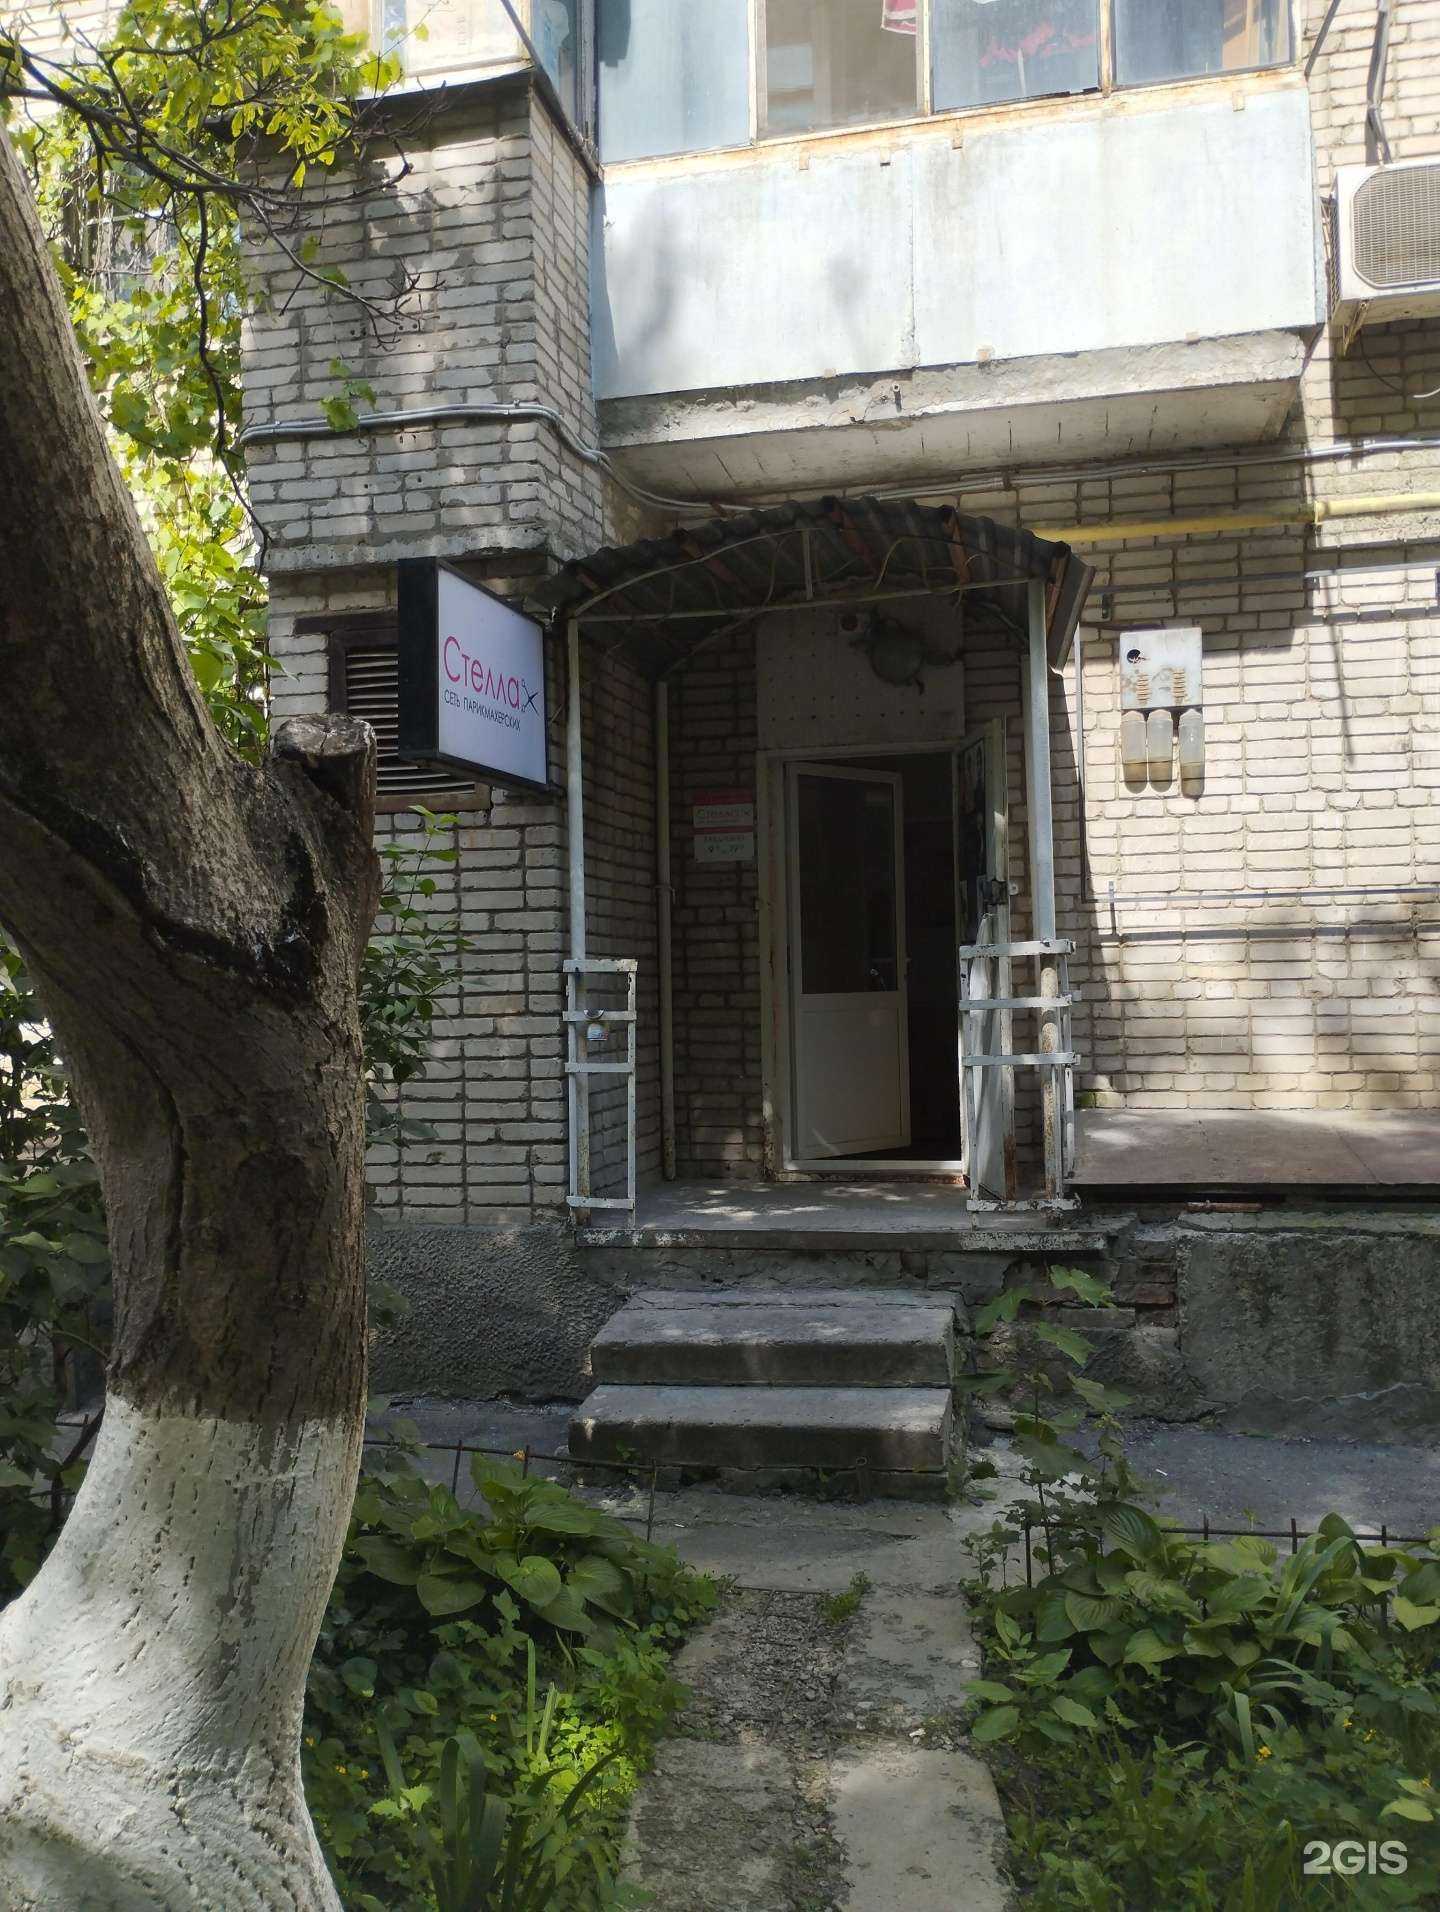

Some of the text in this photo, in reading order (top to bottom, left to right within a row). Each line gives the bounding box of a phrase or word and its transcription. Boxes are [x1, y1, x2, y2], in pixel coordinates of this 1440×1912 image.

[444, 636, 520, 710] Стелла
[444, 689, 521, 731] СЕТЬ ПАРИКМАХЕРСКИХ
